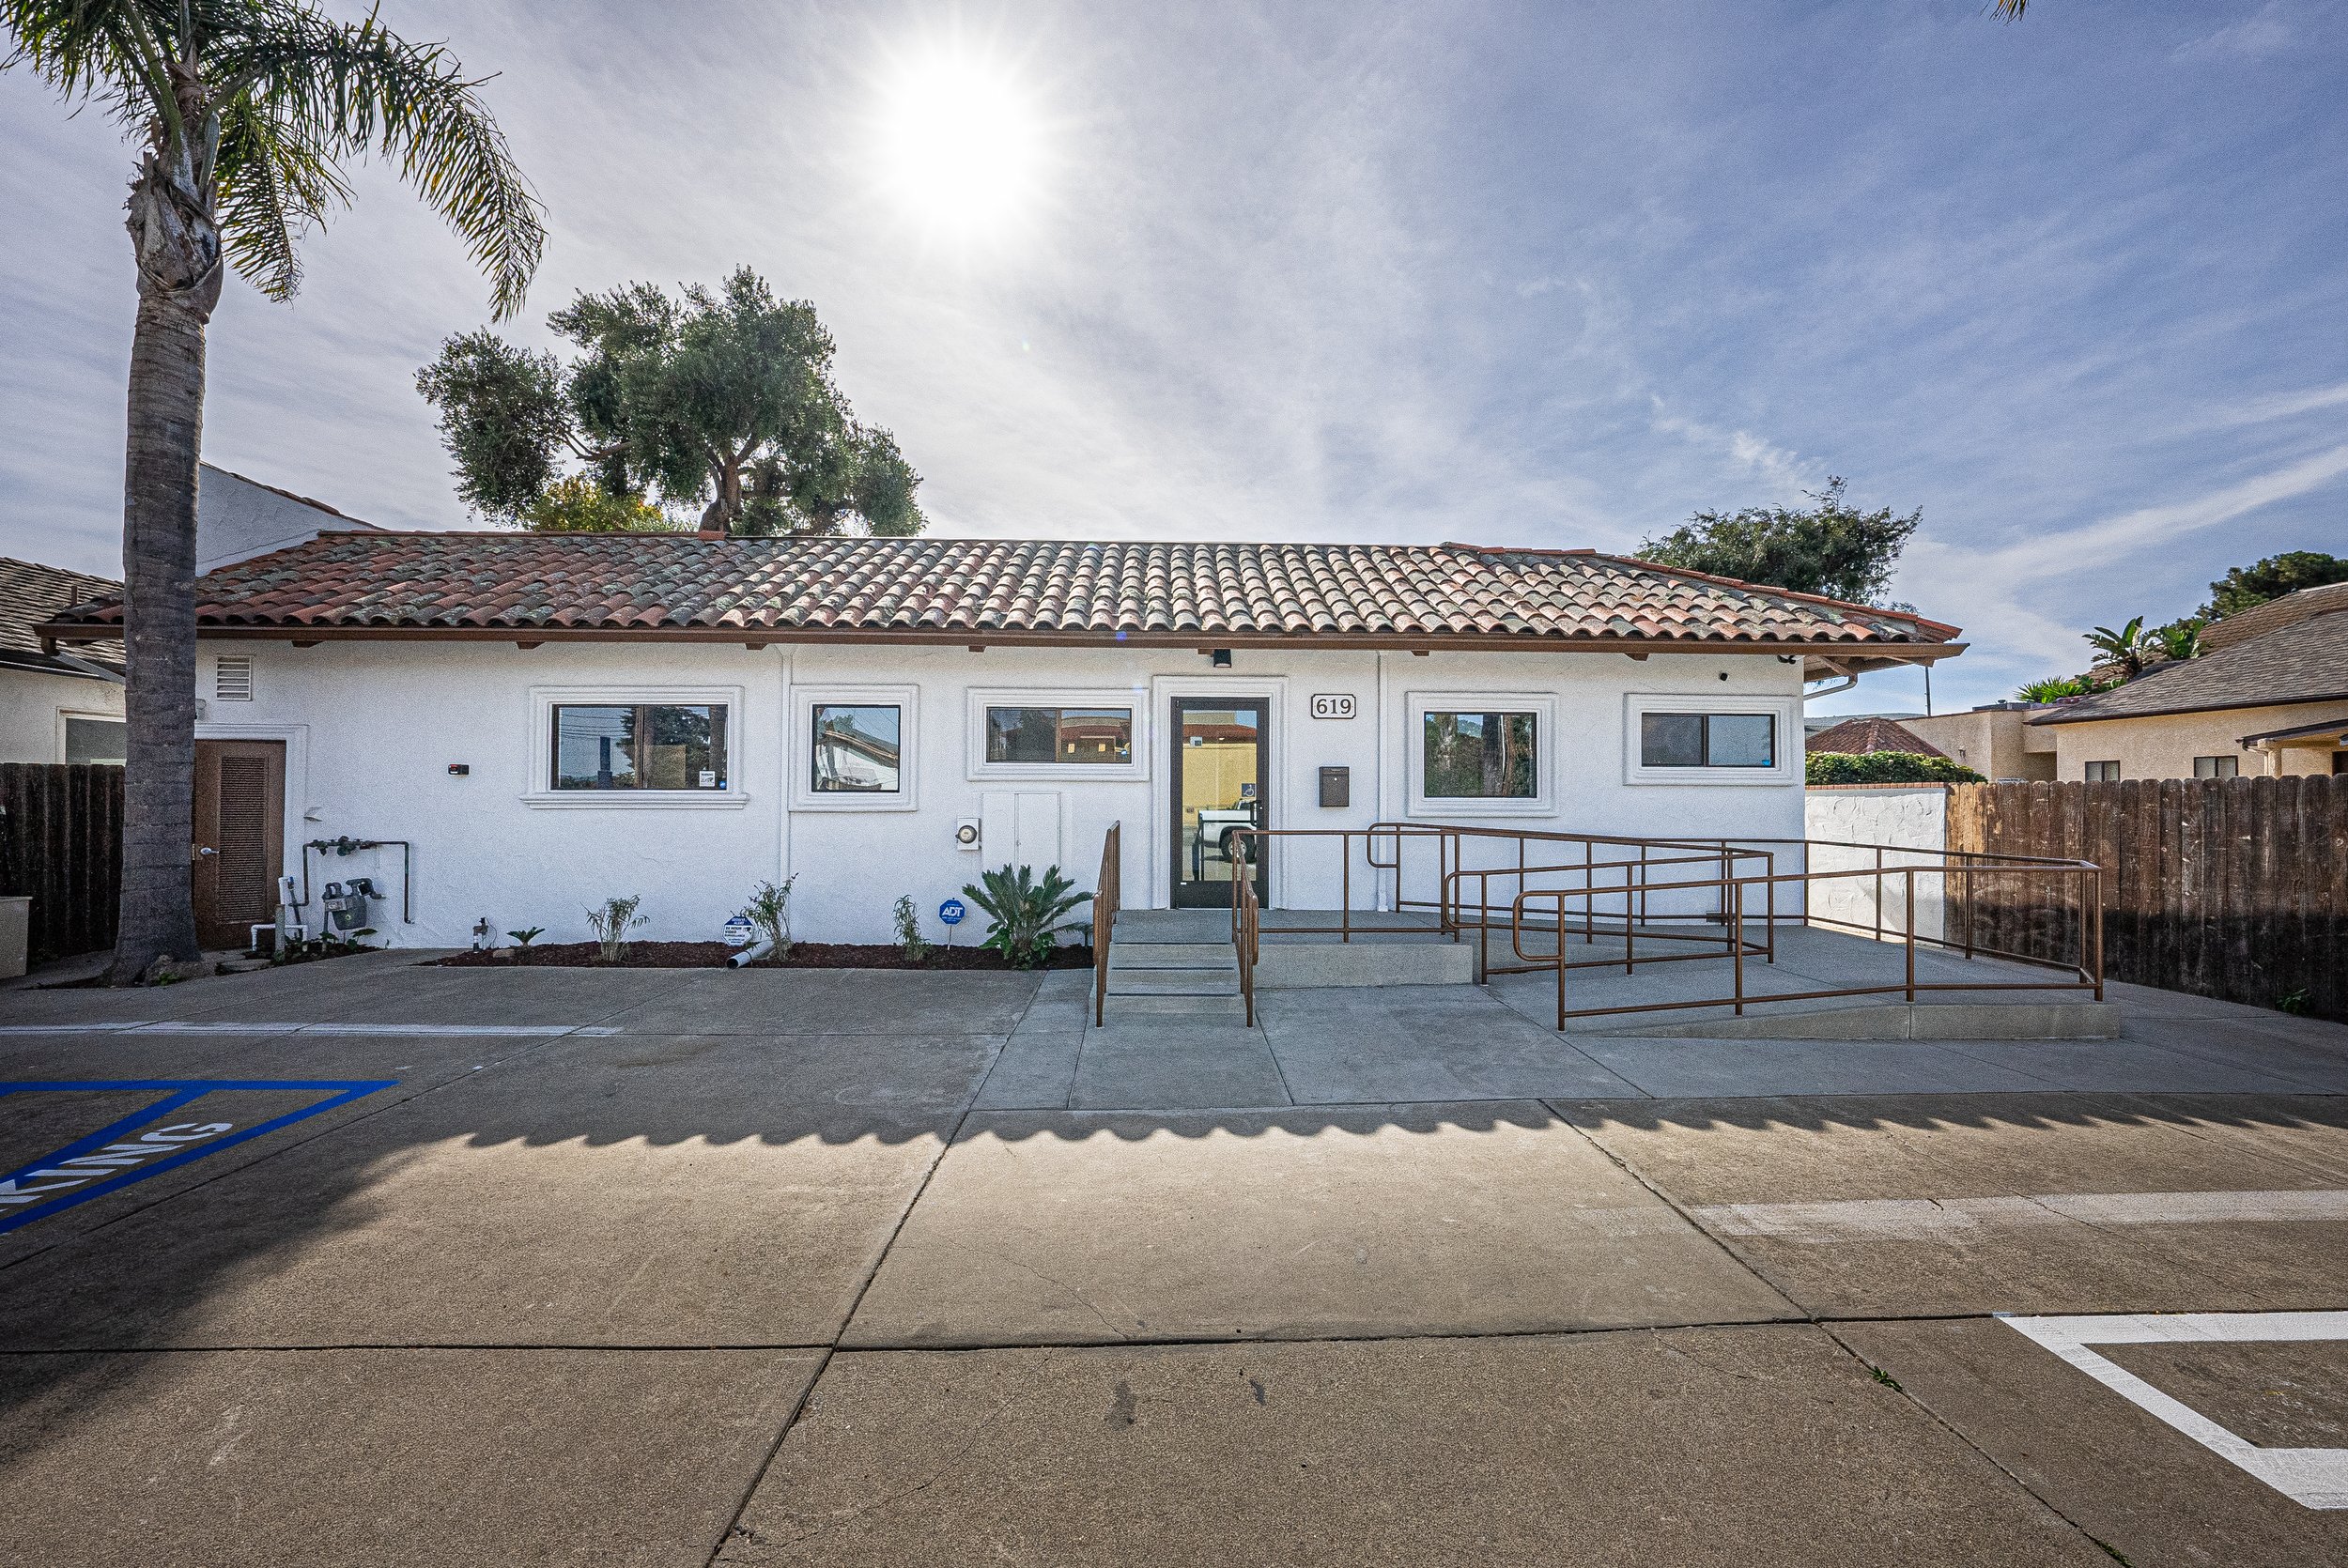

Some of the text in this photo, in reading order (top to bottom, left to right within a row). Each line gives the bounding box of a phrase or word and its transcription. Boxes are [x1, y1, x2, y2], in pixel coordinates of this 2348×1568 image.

[1316, 699, 1352, 715] 619
[942, 907, 963, 916] ADT
[0, 1122, 233, 1212] KING
